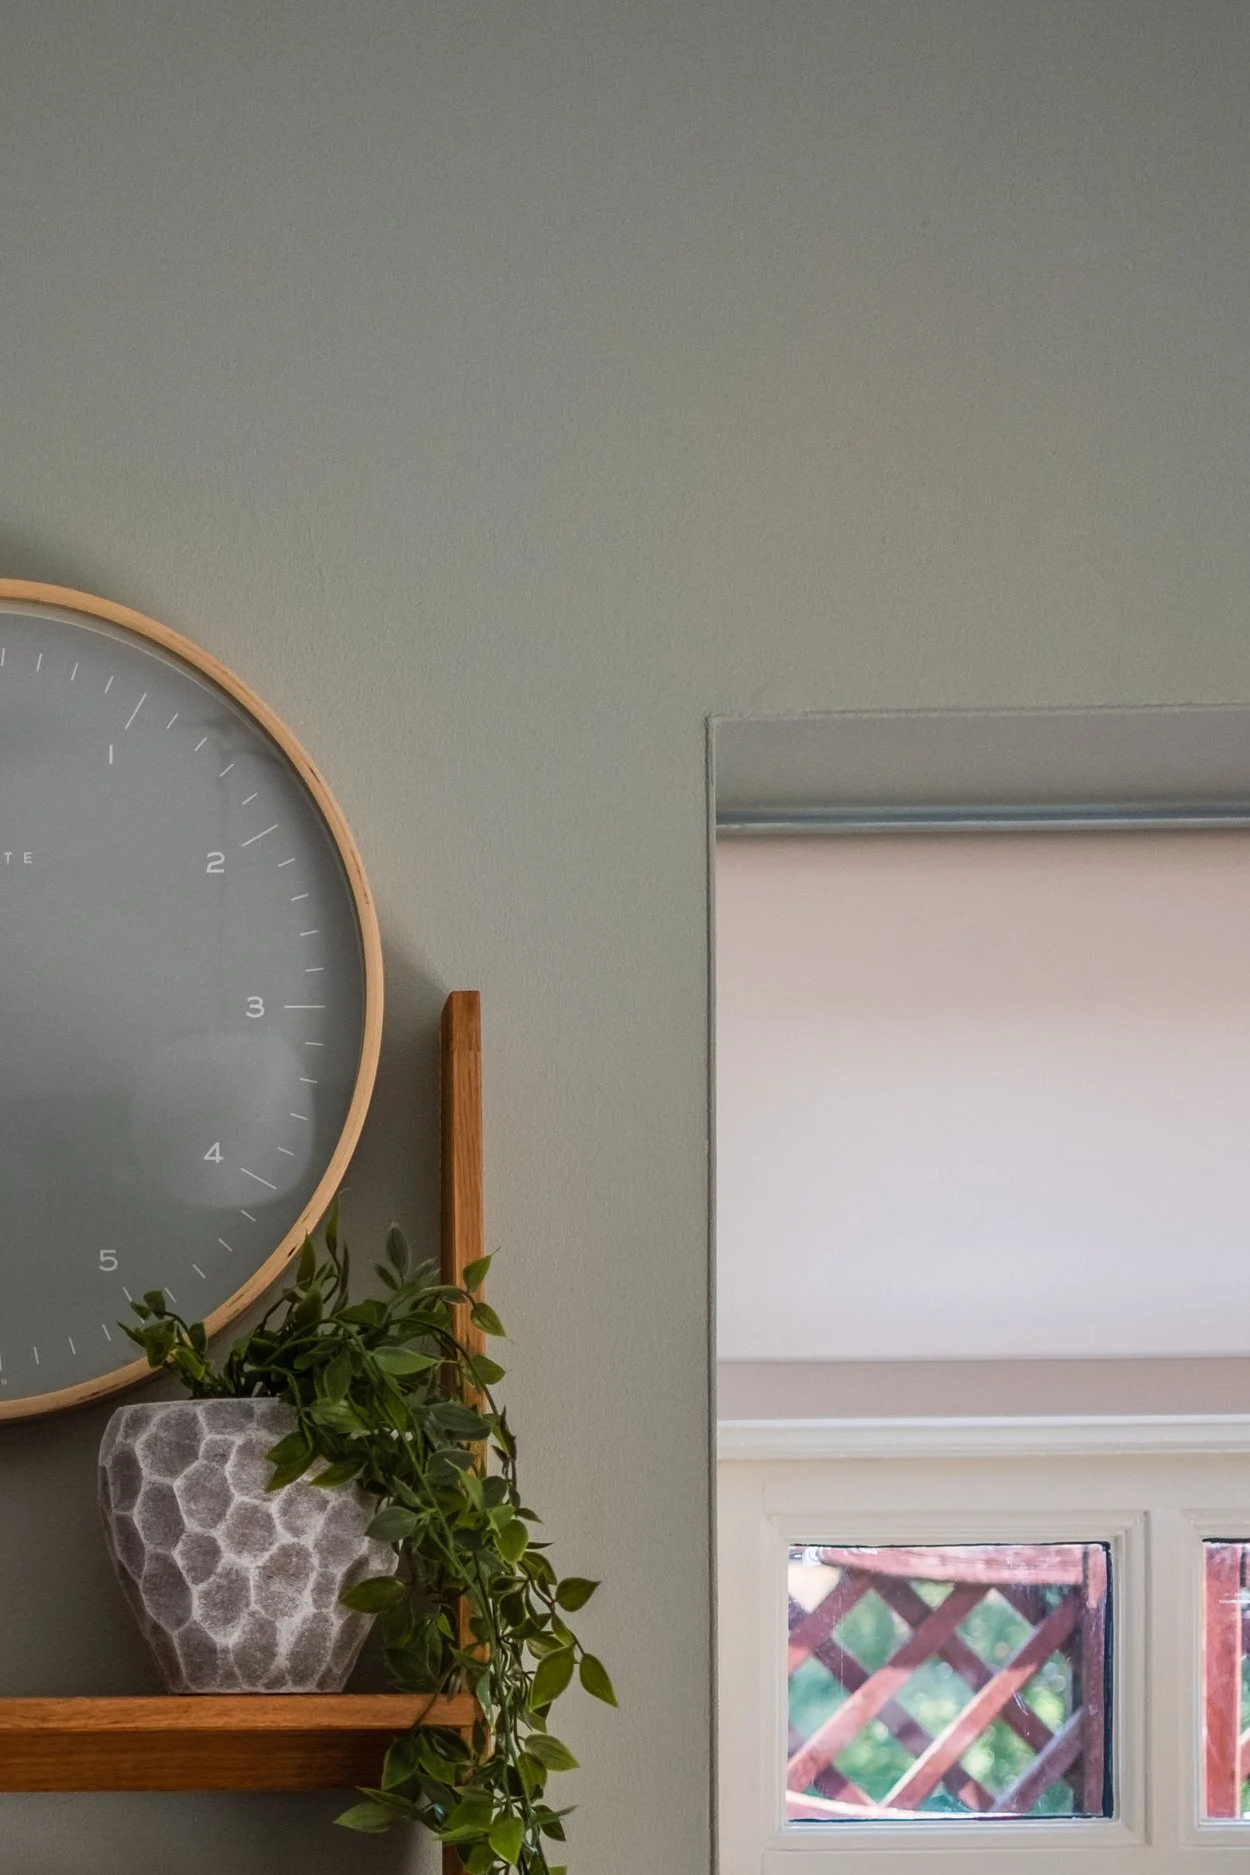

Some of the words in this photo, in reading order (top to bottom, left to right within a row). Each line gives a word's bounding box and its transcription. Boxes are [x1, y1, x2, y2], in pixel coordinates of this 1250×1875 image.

[108, 744, 114, 764] 1
[205, 851, 225, 873] 2
[245, 995, 265, 1018] 3
[203, 1142, 224, 1163] 4
[98, 1249, 119, 1271] 5
